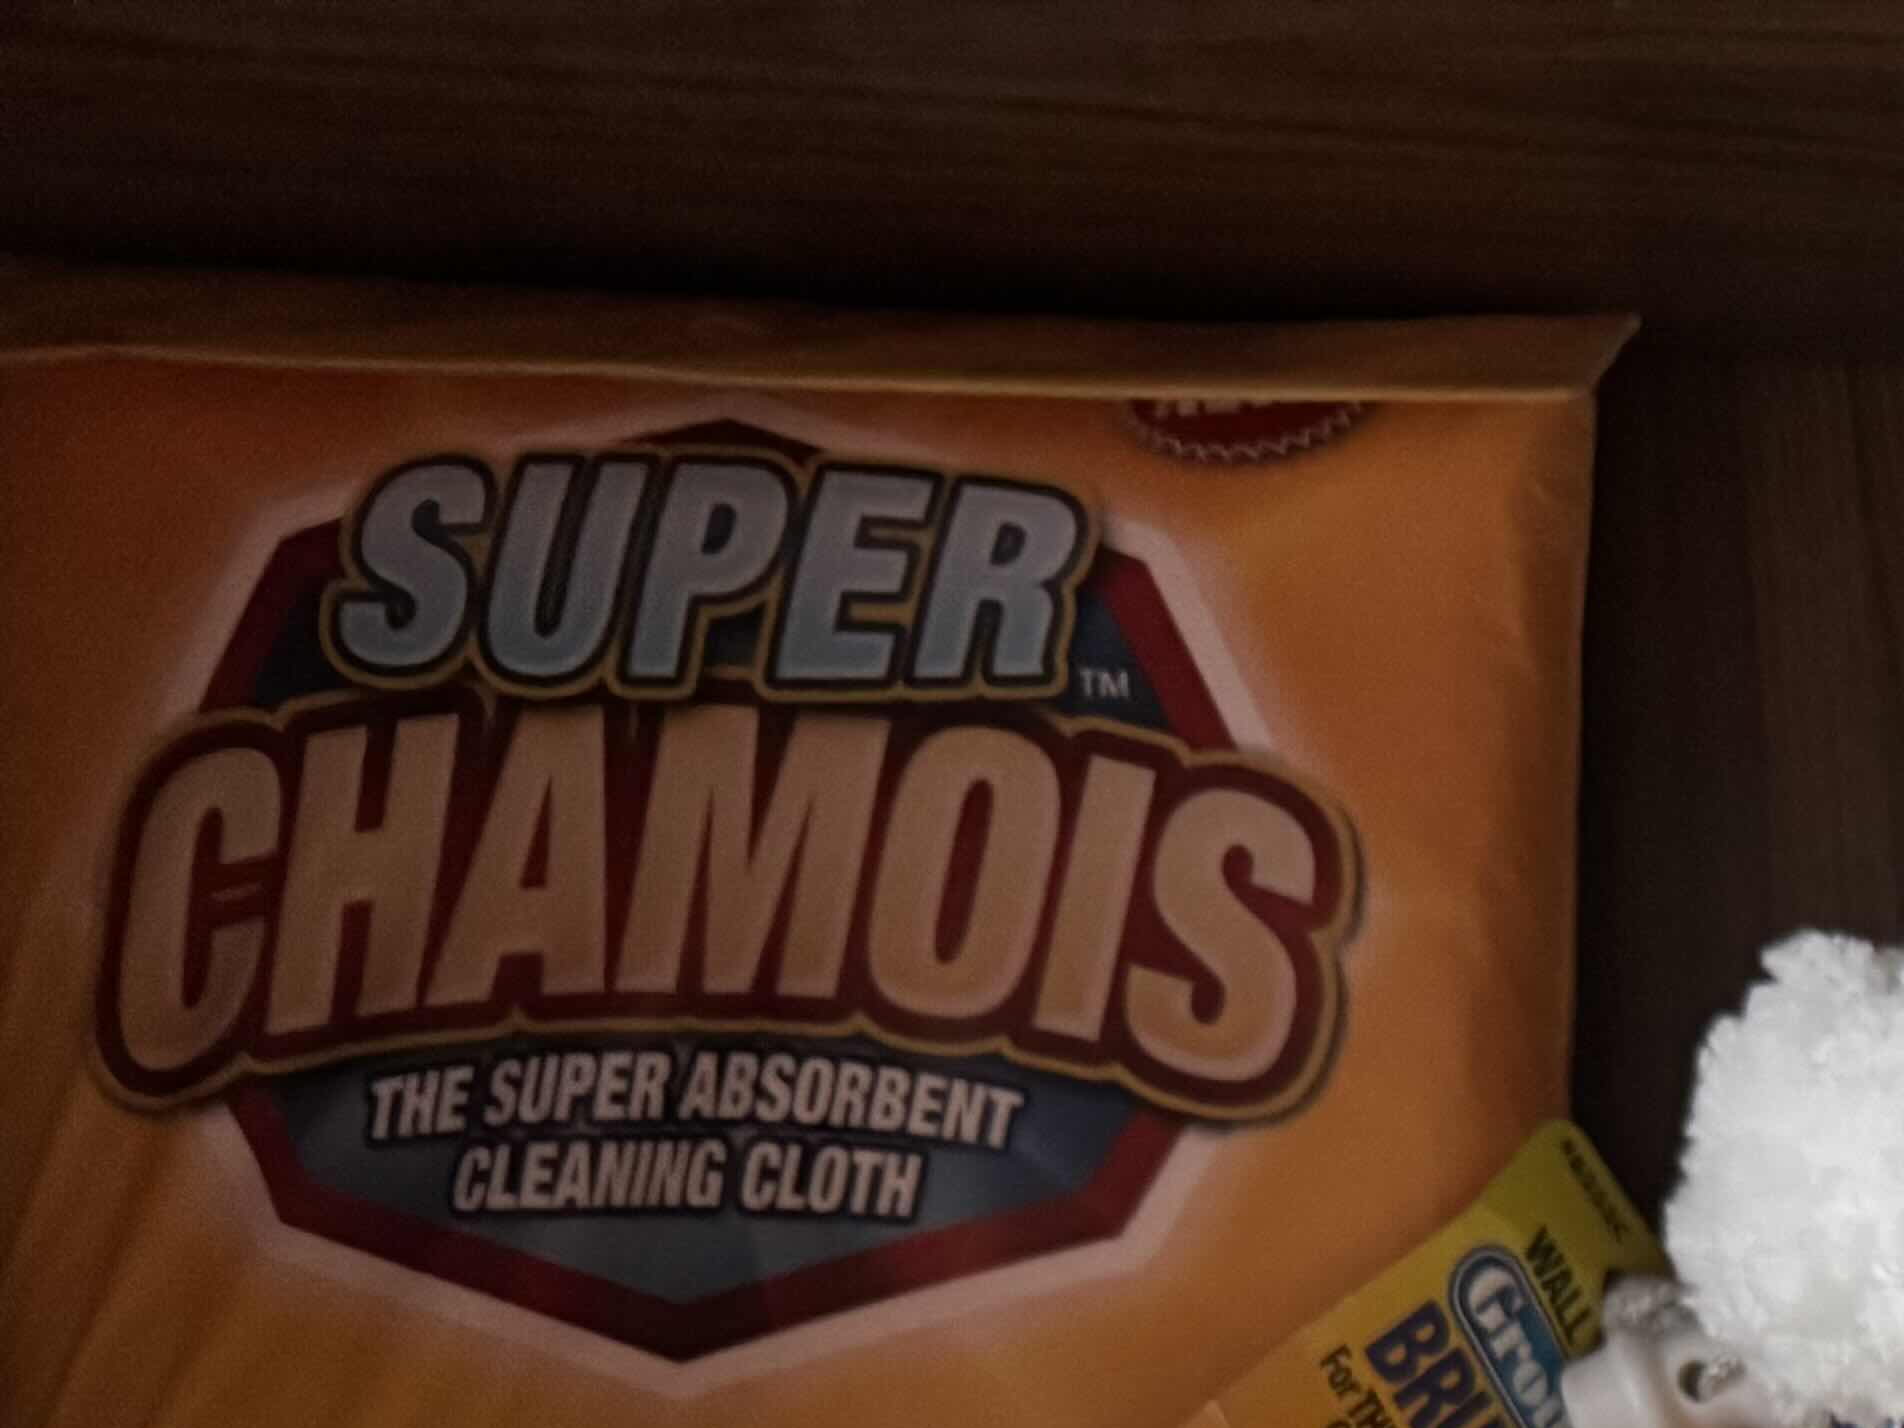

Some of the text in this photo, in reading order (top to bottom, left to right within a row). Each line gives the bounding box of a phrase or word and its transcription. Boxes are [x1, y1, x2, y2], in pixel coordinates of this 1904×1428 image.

[337, 459, 1077, 681] SUPER
[118, 704, 1323, 1080] CHAMOIS
[370, 1050, 1021, 1148] THE SUPER ABSORBENT
[452, 1139, 921, 1219] CLEANING CLOTH
[1526, 1226, 1593, 1342] WALL
[1320, 1344, 1360, 1396] For
